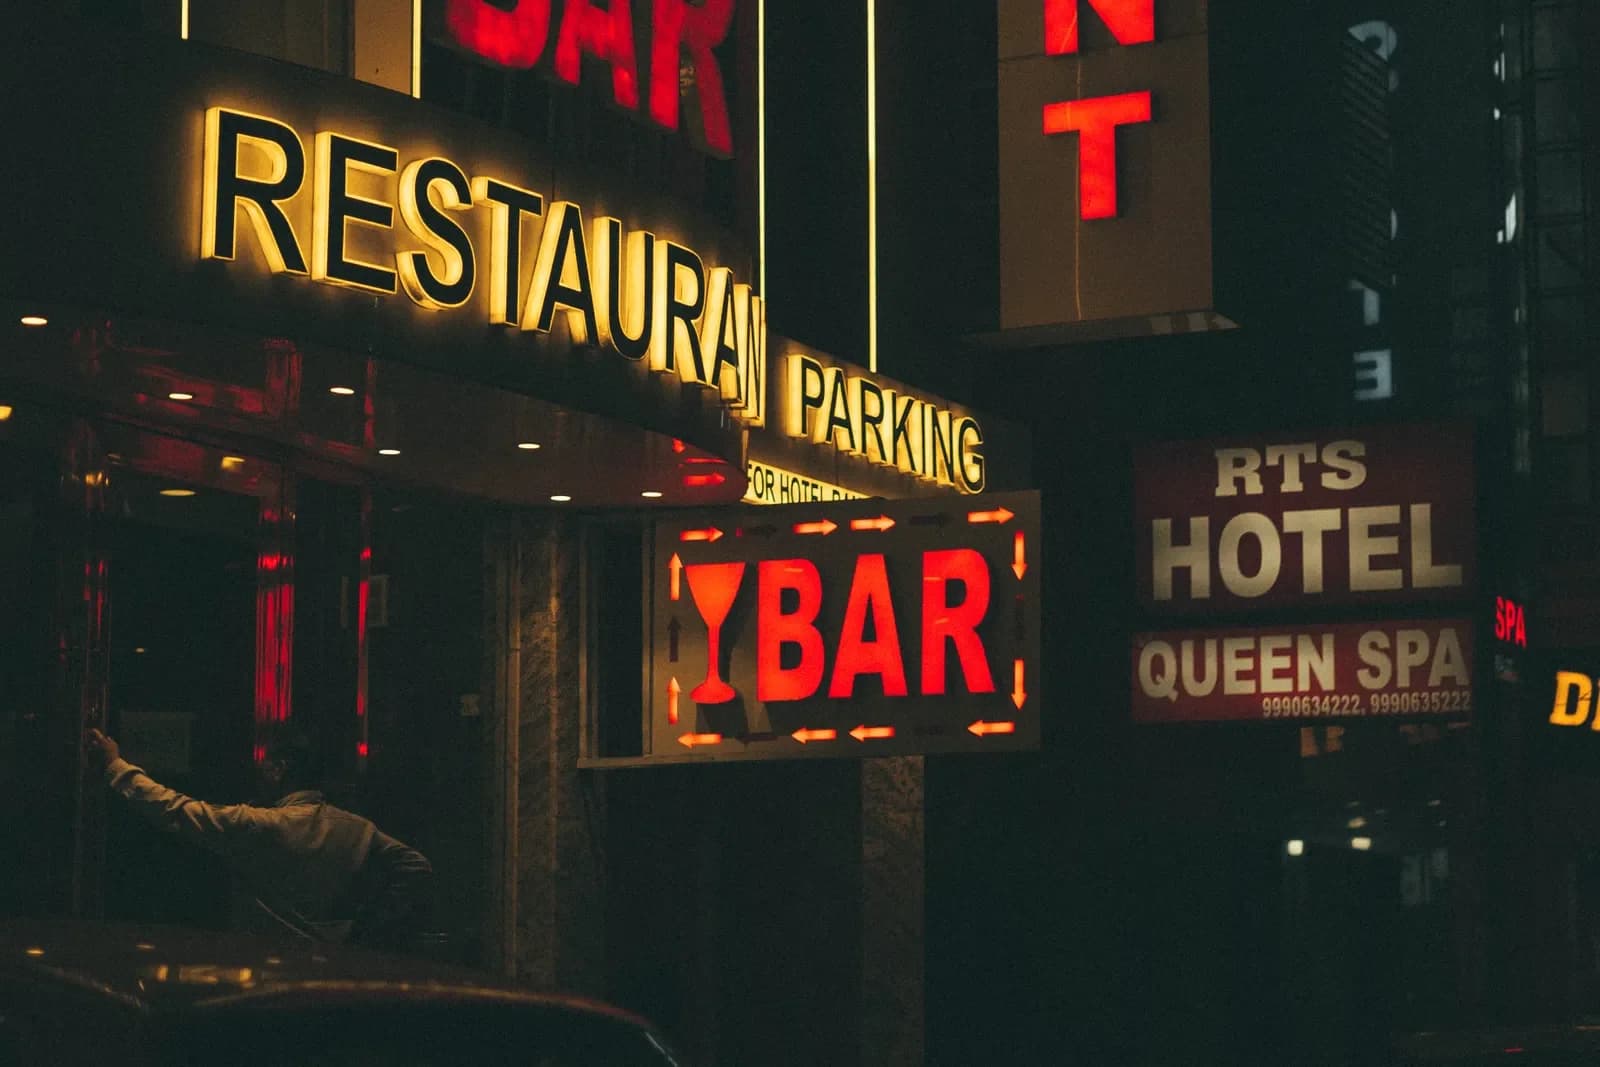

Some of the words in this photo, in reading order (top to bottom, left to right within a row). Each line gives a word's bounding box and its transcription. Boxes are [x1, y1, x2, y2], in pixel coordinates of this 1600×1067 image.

[446, 0, 735, 157] AR
[787, 354, 985, 495] PARKING
[1214, 440, 1368, 497] RTS
[1151, 502, 1463, 601] HOTEL
[757, 548, 996, 703] BAR
[1495, 595, 1527, 648] SPA
[1137, 633, 1336, 703] QUEEN
[1356, 627, 1470, 690] SPA
[1370, 691, 1472, 714] 9990635222
[1548, 670, 1600, 732] D
